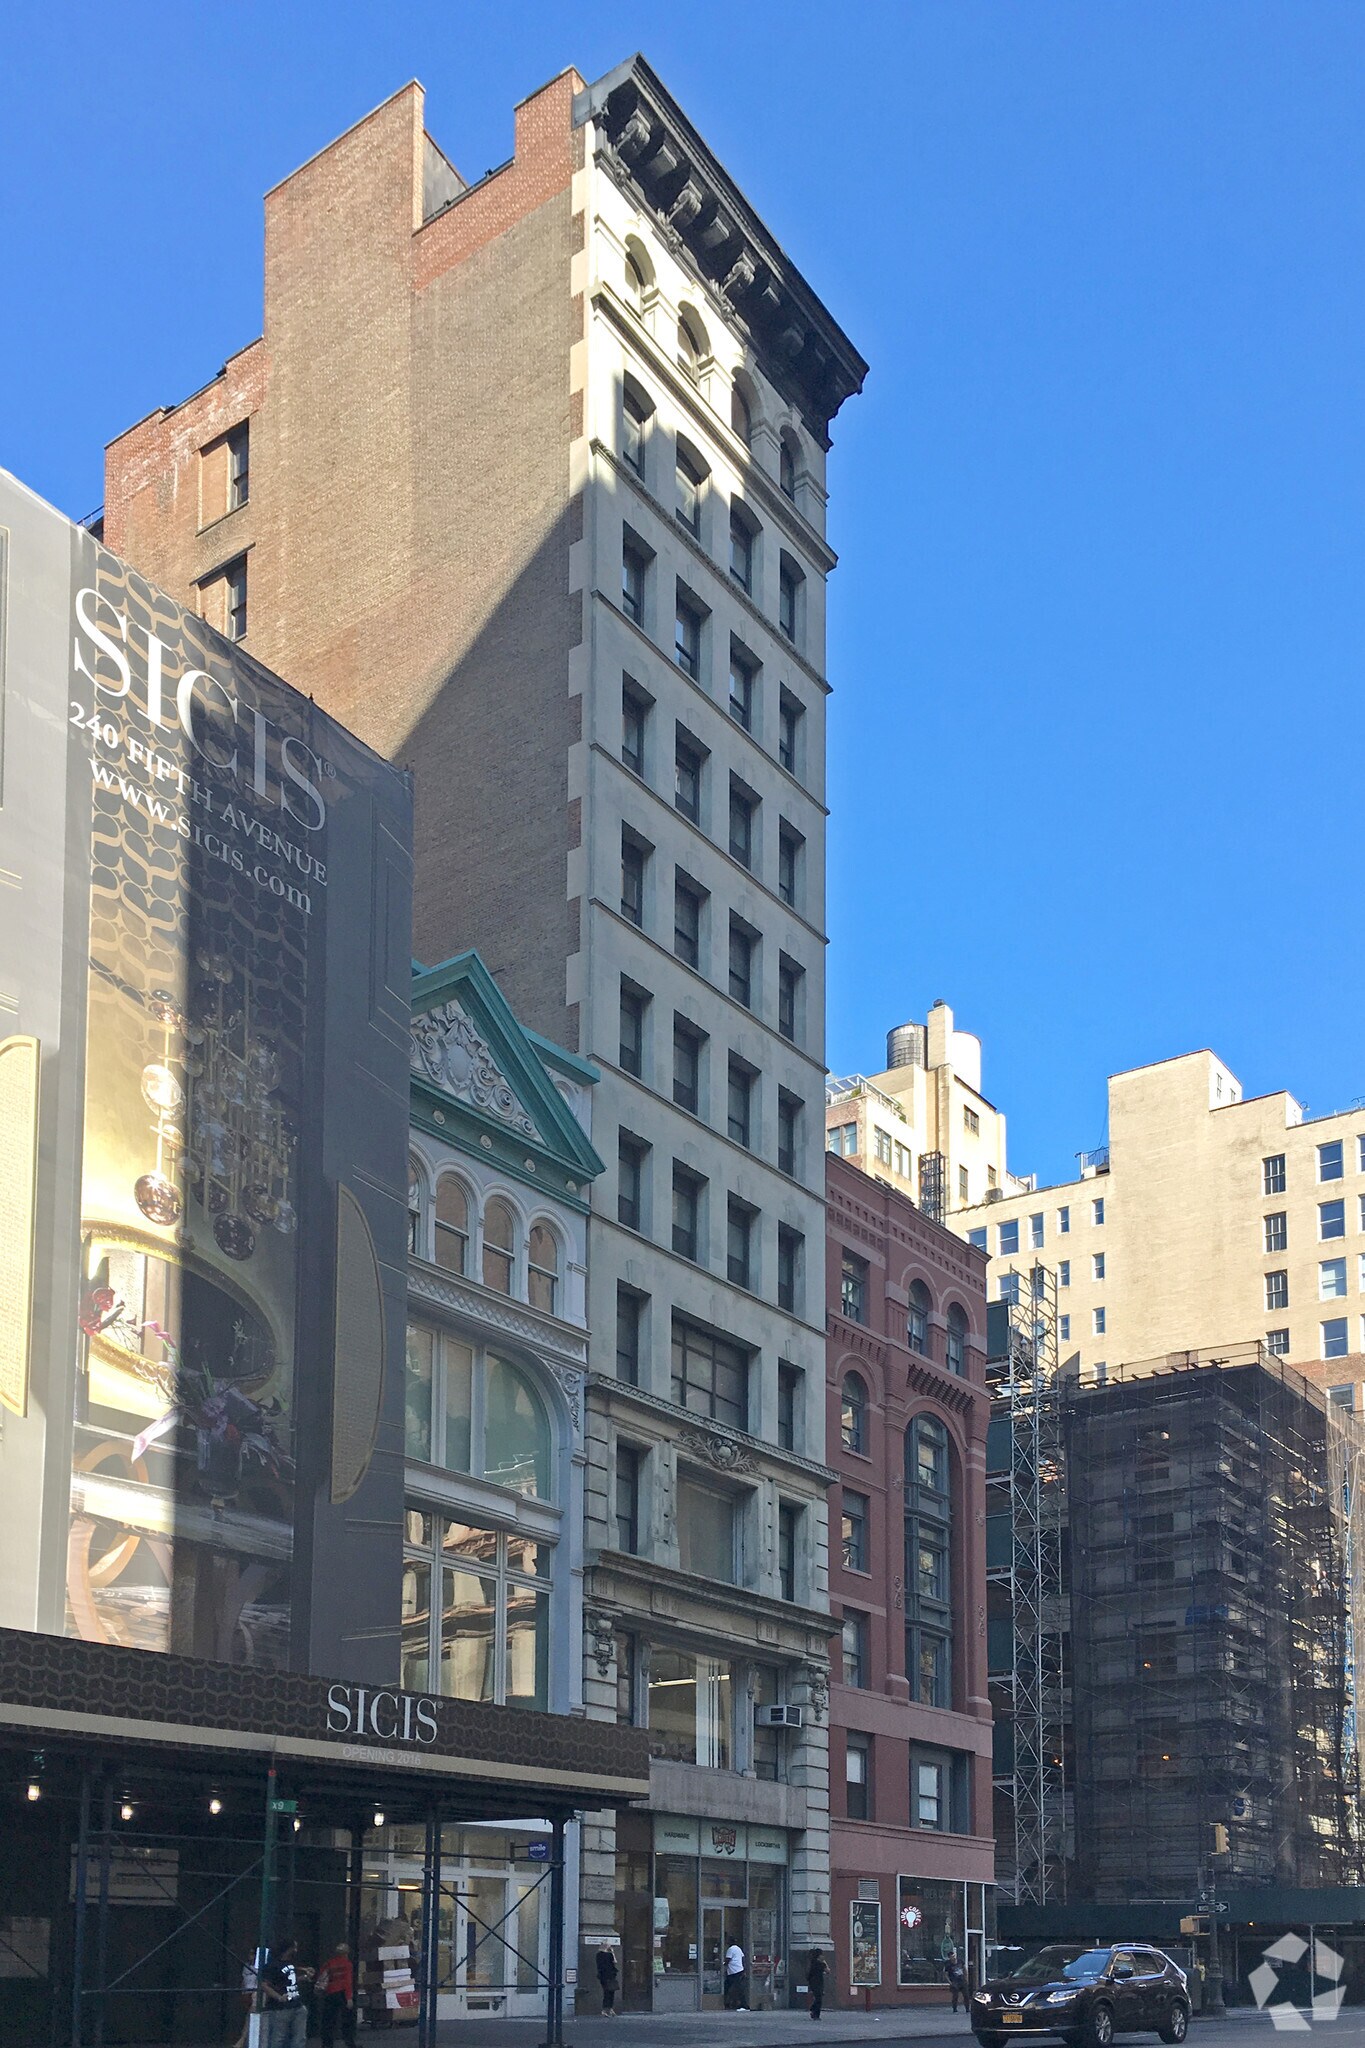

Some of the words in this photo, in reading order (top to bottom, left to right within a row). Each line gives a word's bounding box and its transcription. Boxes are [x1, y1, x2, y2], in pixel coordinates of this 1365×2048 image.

[68, 701, 119, 749] 240
[127, 736, 214, 813] FIFTH
[220, 803, 329, 887] AVENUE
[88, 757, 313, 916] www.SICIS.com
[342, 1746, 395, 1763] OPENING
[398, 1752, 421, 1766] 2016
